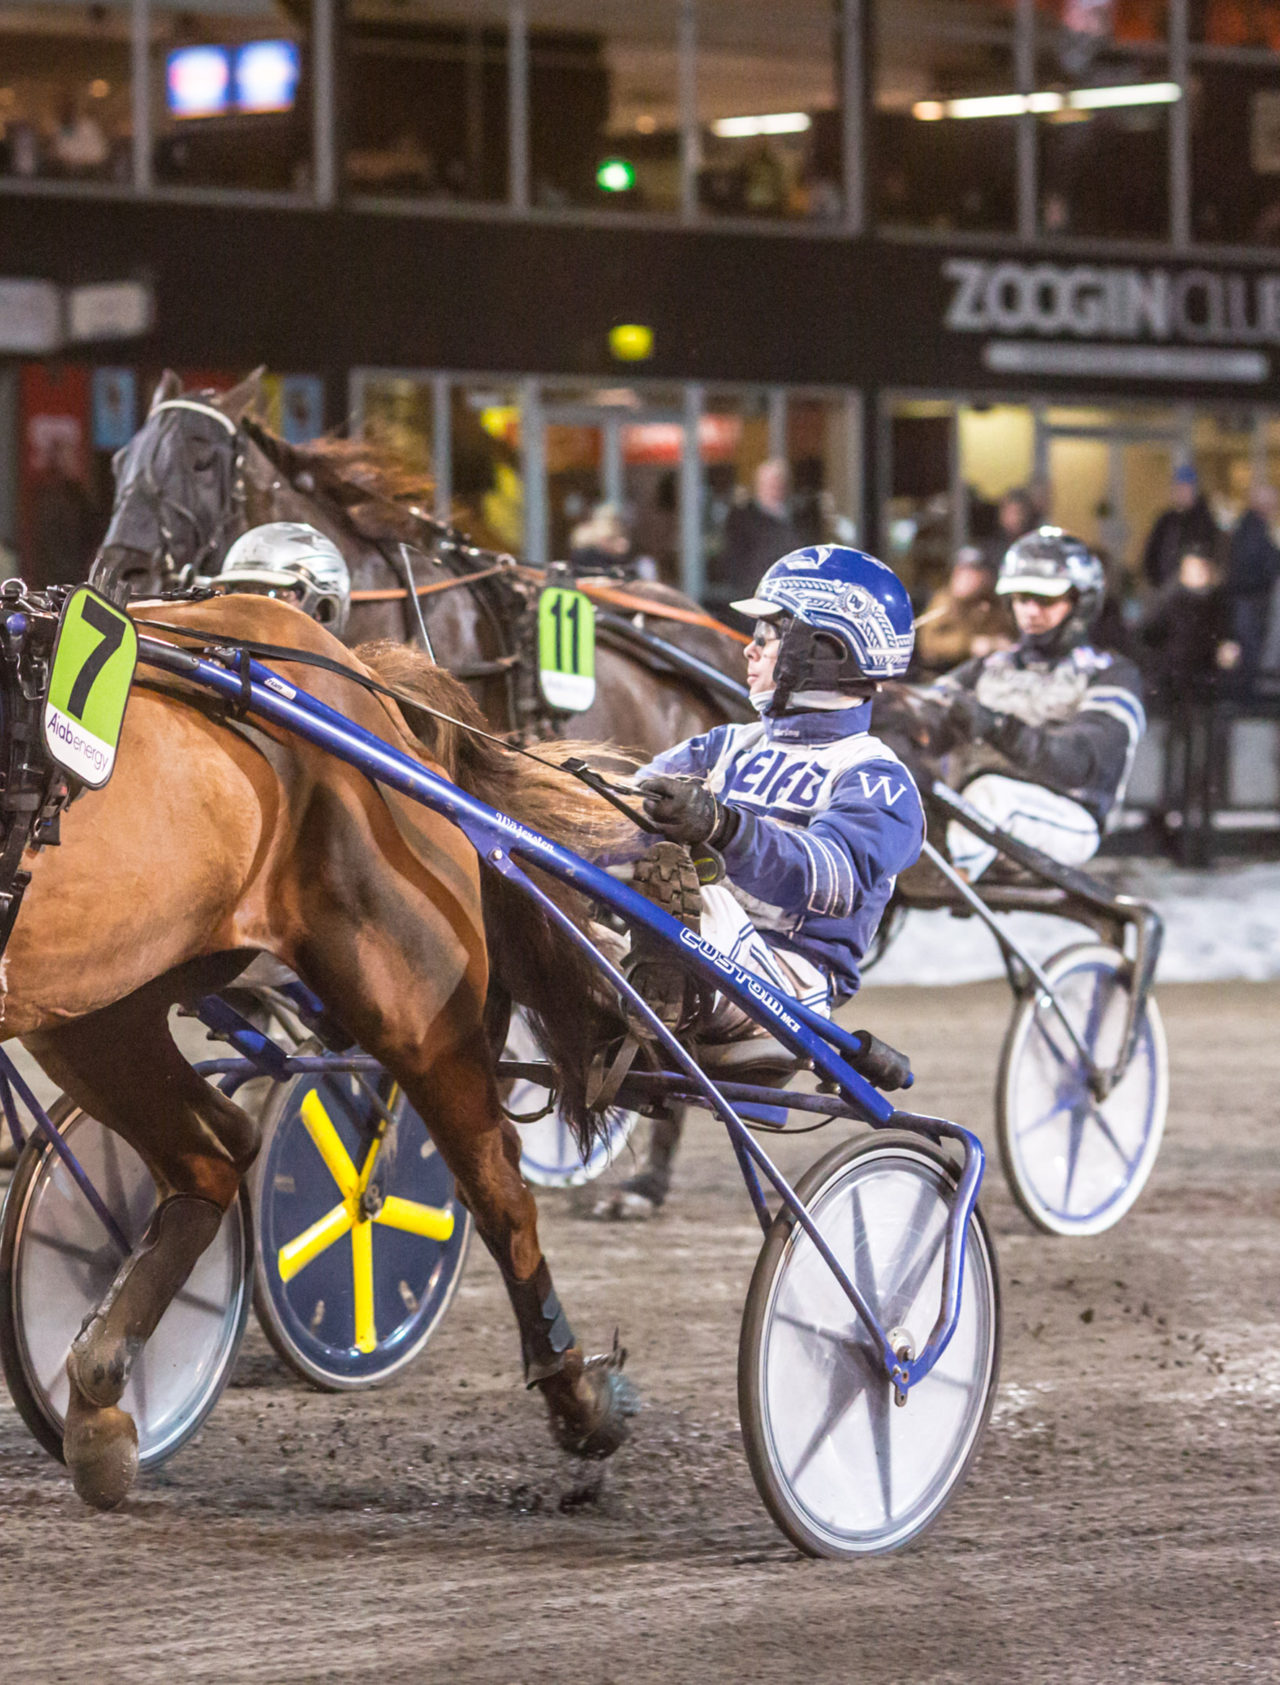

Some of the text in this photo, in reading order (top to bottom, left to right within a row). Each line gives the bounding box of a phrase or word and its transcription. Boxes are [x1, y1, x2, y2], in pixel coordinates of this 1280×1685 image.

[67, 594, 126, 720] 7
[550, 594, 579, 675] 11
[857, 771, 908, 807] W
[680, 927, 785, 1017] CUSTOM
